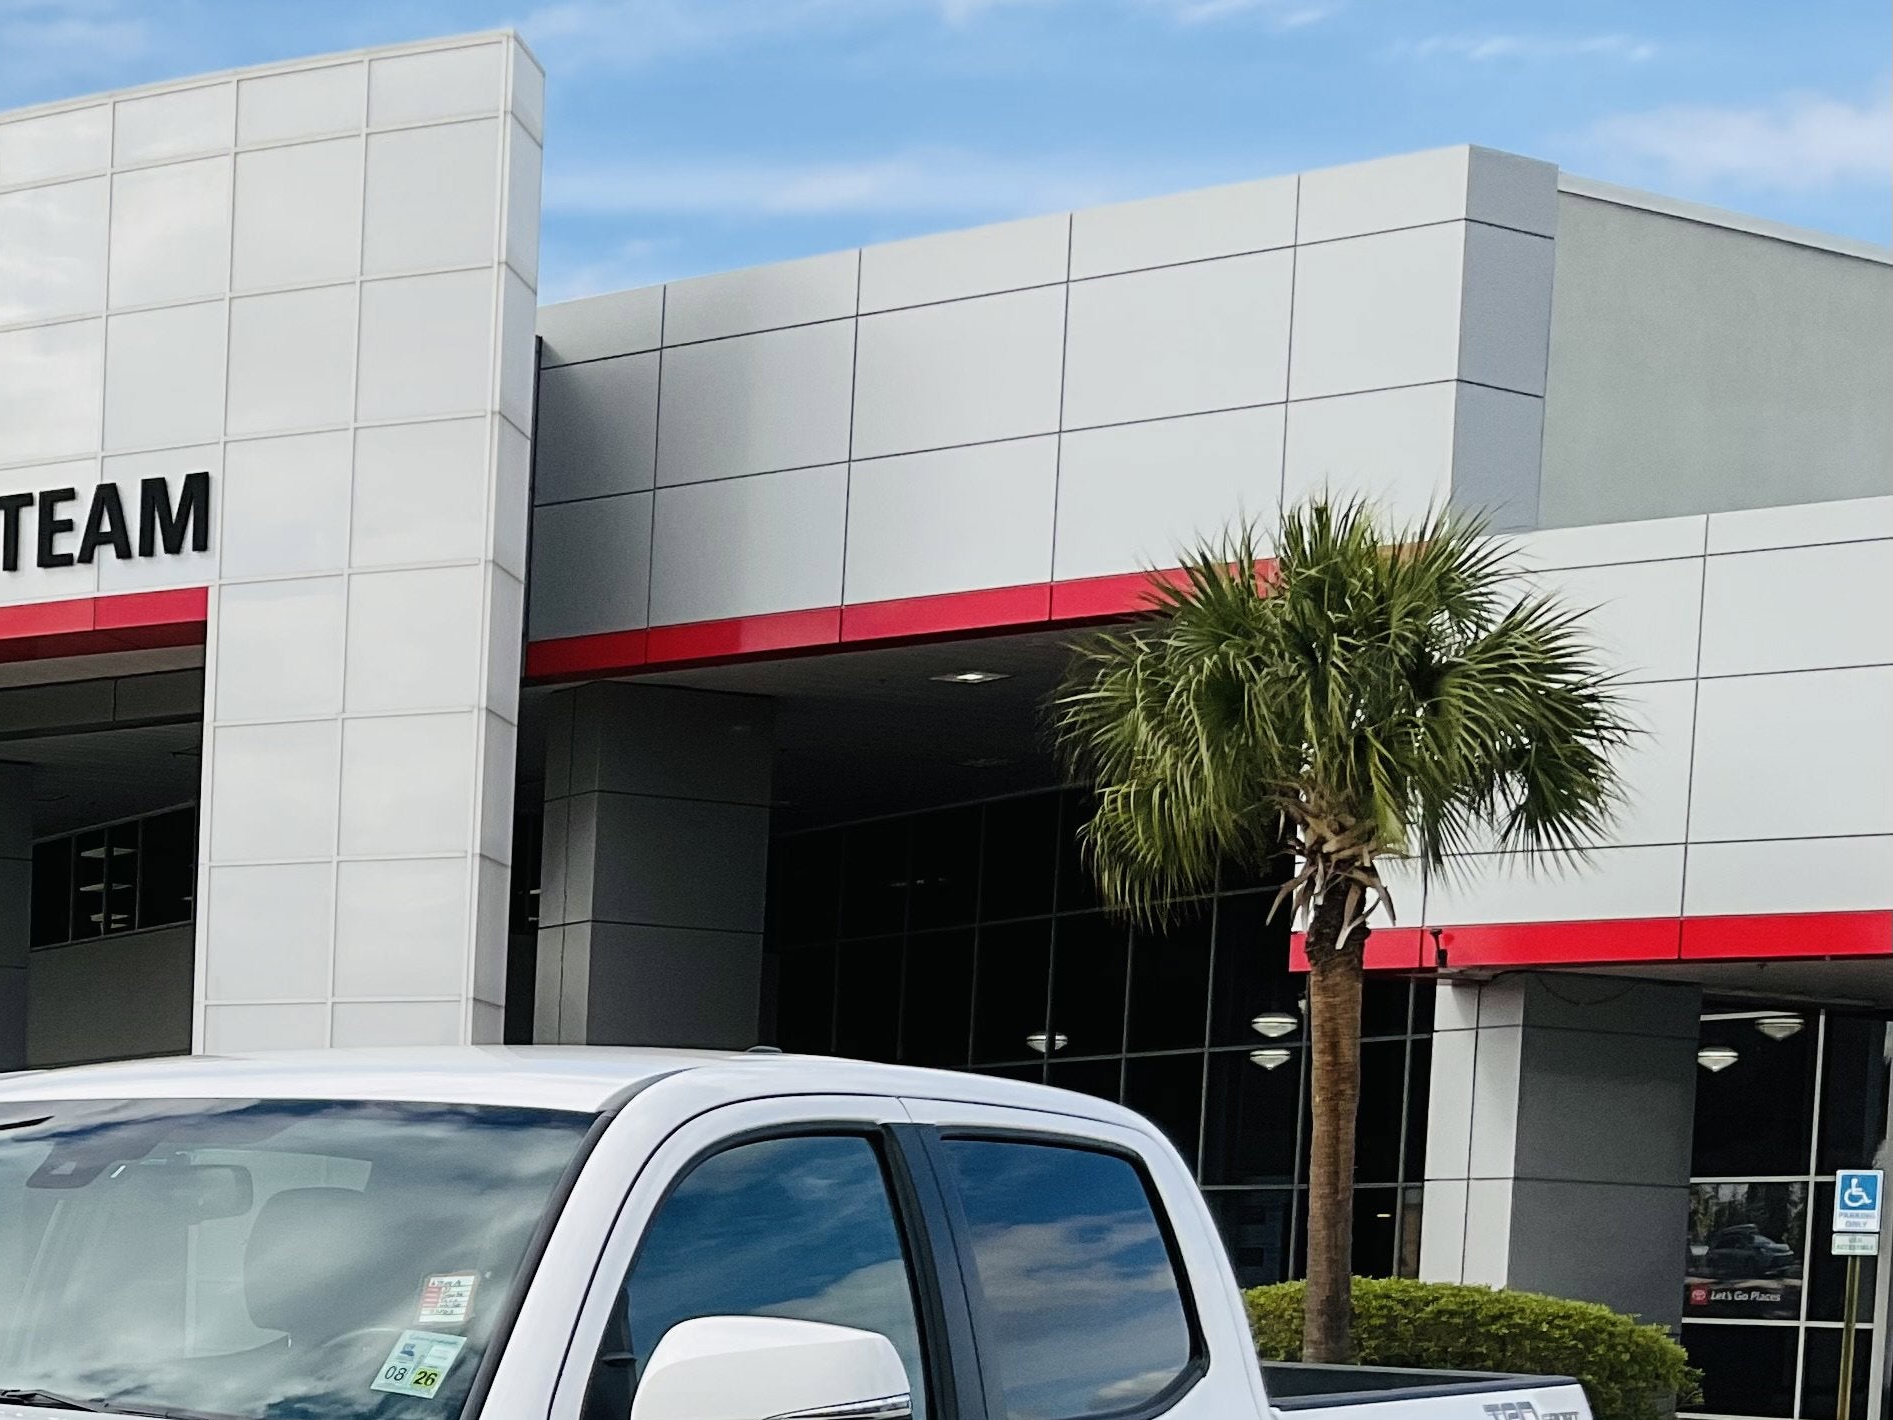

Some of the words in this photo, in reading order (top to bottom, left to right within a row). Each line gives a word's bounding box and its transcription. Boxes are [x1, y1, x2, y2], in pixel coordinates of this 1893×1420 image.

[1710, 1290, 1733, 1301] Let's
[1734, 1290, 1749, 1301] Go
[1750, 1291, 1782, 1302] Places
[384, 1365, 408, 1382] 08
[413, 1370, 438, 1387] 26
